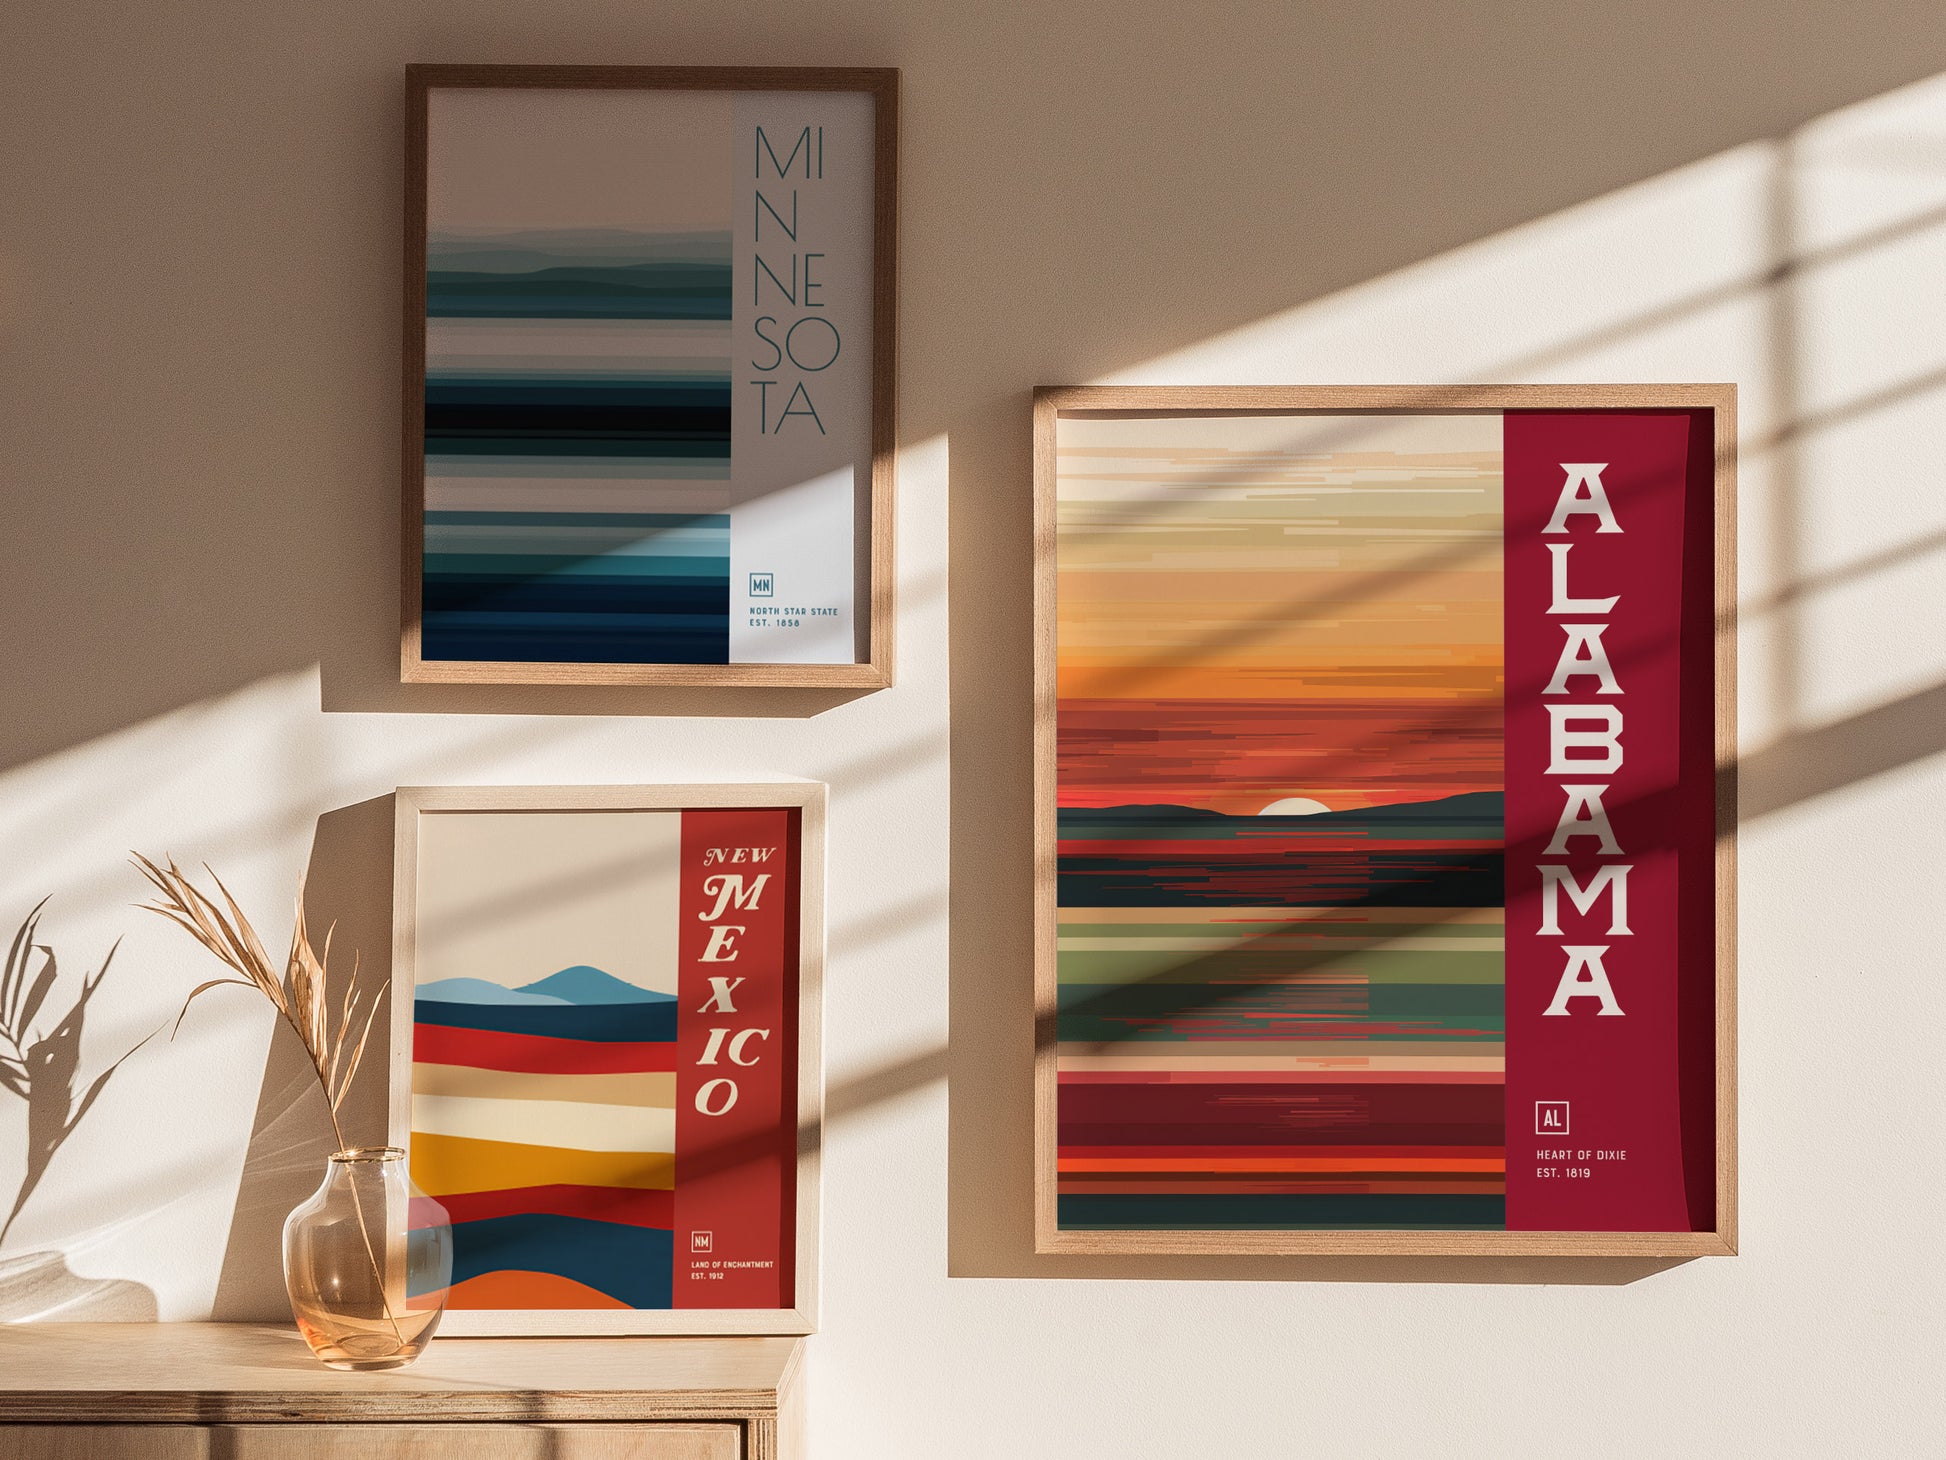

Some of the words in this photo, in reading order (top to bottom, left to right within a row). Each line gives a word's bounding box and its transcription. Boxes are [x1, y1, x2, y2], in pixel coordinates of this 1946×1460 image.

[753, 579, 770, 592] MN
[749, 607, 780, 616] NORTH
[784, 607, 807, 616] STAR
[810, 608, 839, 617] STATE
[749, 618, 771, 627] EST.
[776, 619, 800, 628] 1858
[1535, 463, 1635, 1016] ALABAMA
[703, 847, 777, 867] NEW
[1543, 1109, 1562, 1127] AL
[1536, 1149, 1573, 1160] HEART
[1577, 1150, 1592, 1161] OF
[1596, 1150, 1627, 1161] DIXIE
[1536, 1167, 1561, 1178] EST.
[1565, 1168, 1591, 1178] 1819
[695, 1235, 709, 1248] NM
[691, 1261, 710, 1269] LAND
[712, 1261, 721, 1269] OF
[723, 1261, 774, 1269] ENCHANTMENT
[691, 1272, 706, 1280] EST.
[709, 1272, 724, 1280] 1912
